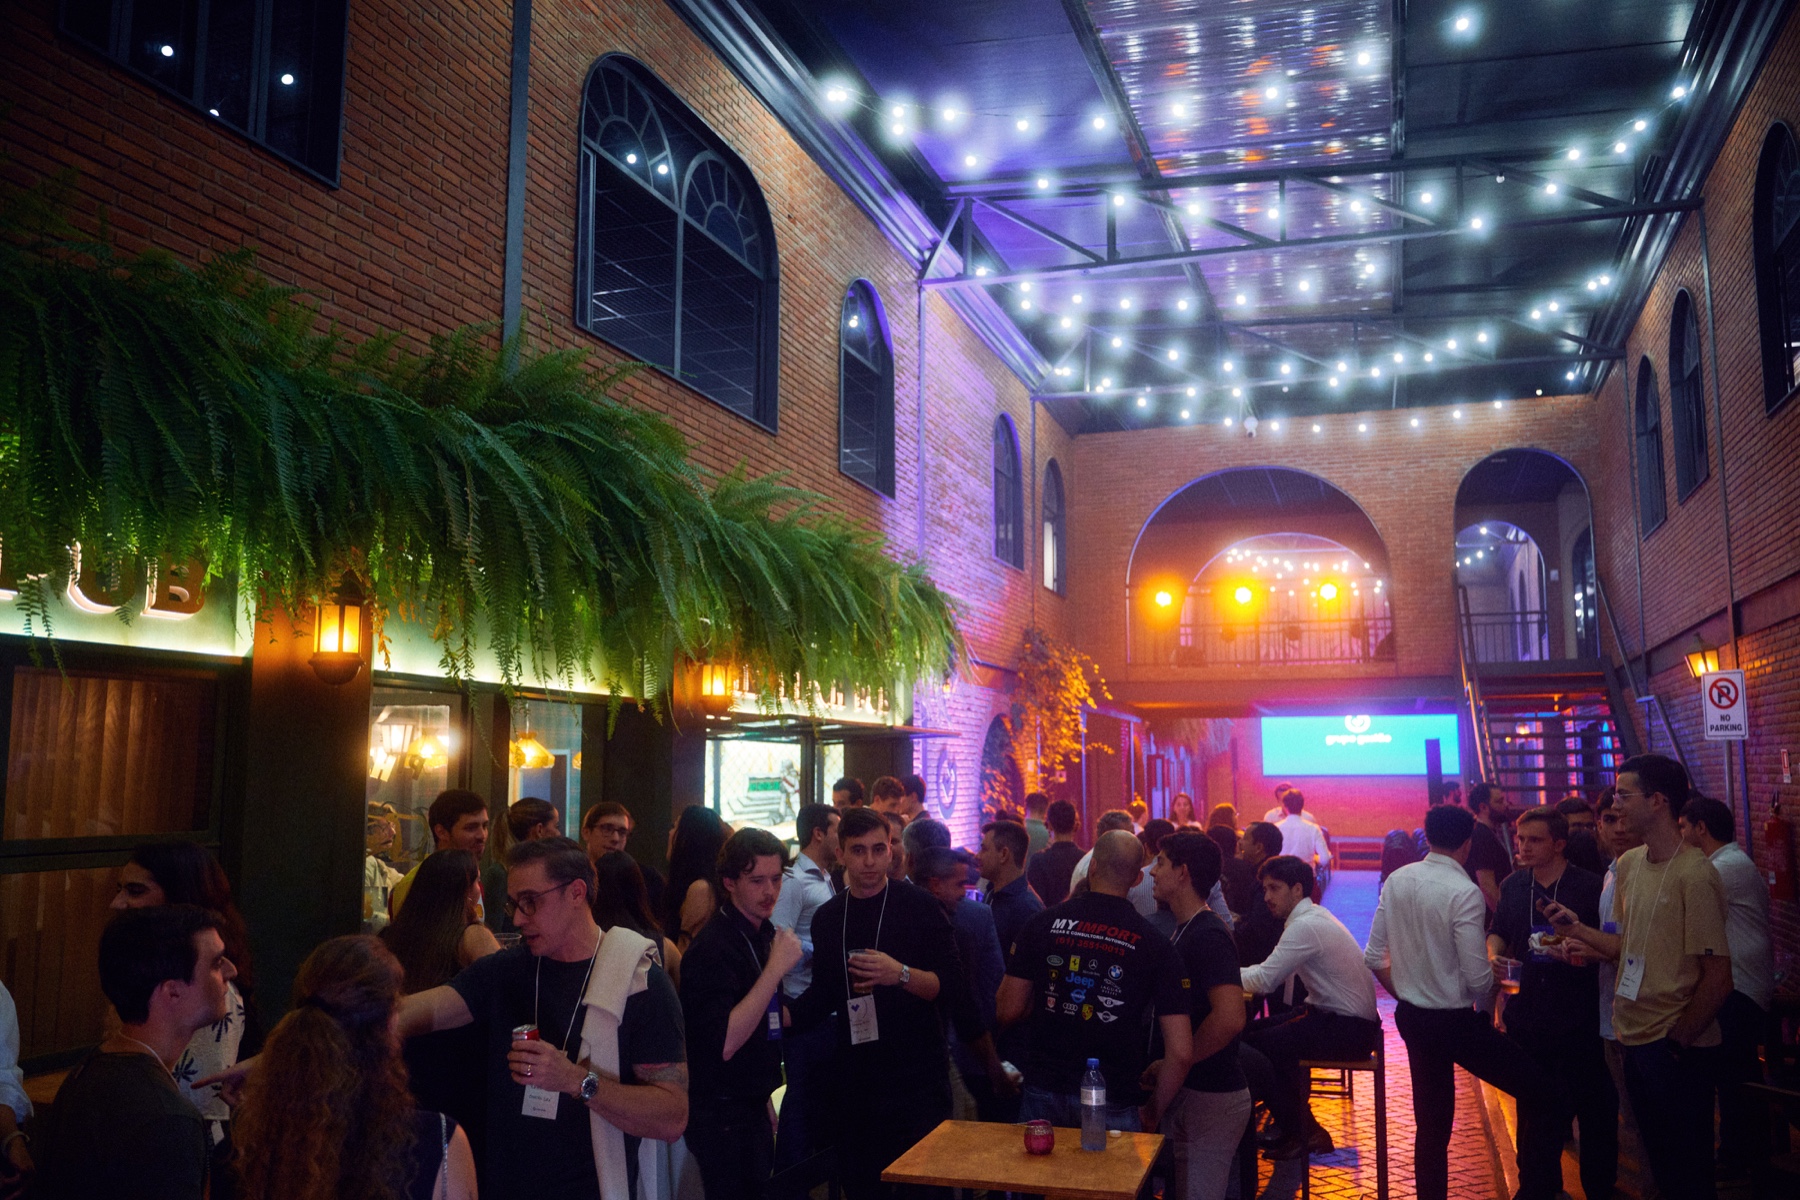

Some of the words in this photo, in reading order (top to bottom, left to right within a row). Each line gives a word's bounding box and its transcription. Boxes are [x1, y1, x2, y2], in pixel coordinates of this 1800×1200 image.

[1720, 713, 1731, 722] NO
[1709, 723, 1743, 732] PARKING
[1070, 930, 1104, 941] CONSULTORIA
[1104, 936, 1136, 951] AUTOMOTIVA
[1065, 971, 1095, 989] Jeep
